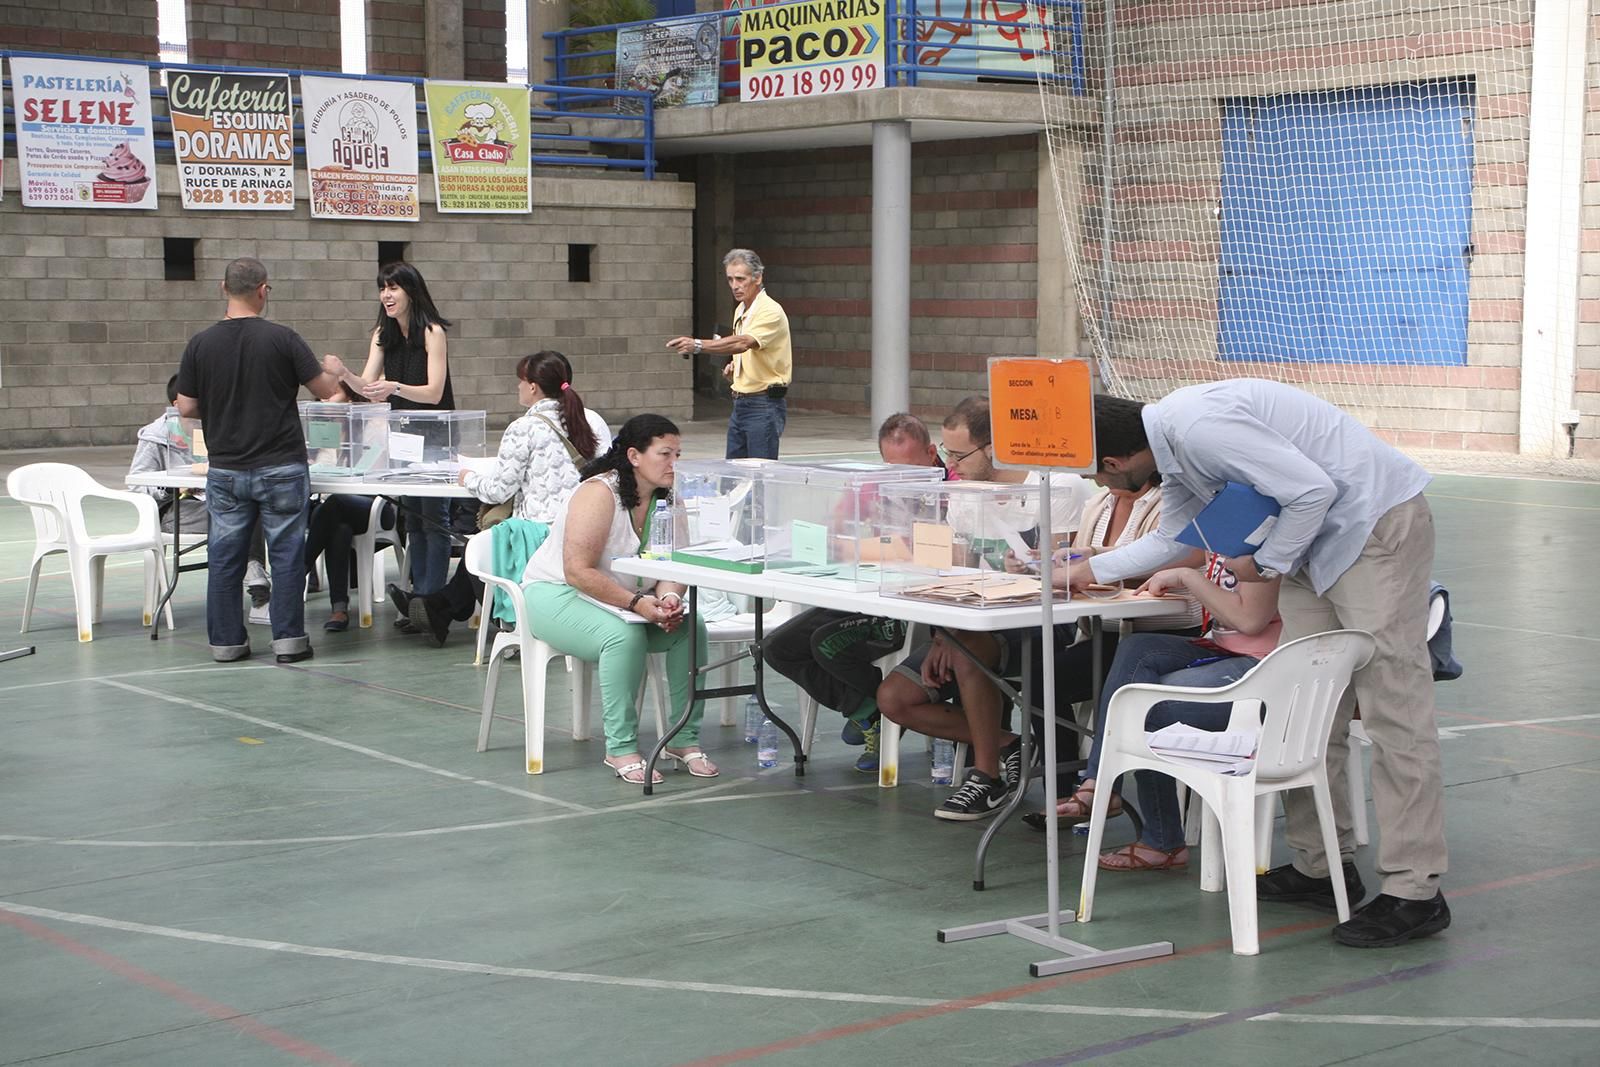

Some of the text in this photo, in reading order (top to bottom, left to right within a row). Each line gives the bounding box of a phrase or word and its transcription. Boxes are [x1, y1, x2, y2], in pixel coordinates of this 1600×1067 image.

[744, 0, 880, 32] MAQUINARIAS
[23, 75, 123, 92] PASTELERÍA
[749, 64, 876, 100] 902 18 99 99
[171, 74, 288, 120] Cafetería
[24, 98, 135, 126] SELENE
[344, 92, 378, 104] ASADERO
[380, 100, 390, 110] DE
[390, 109, 408, 140] POLLOS
[40, 124, 76, 133] Servicio
[88, 126, 128, 135] domicilio
[212, 112, 288, 131] ESQUINA
[175, 130, 292, 161] DORAMAS
[454, 148, 504, 160] Casa Eladio
[184, 166, 195, 175] C/
[198, 166, 260, 178] DORAMAS,
[280, 168, 286, 176] 2
[370, 174, 384, 182] POR
[184, 178, 292, 188] RUCE DE ARINAGA
[192, 188, 224, 203] 928
[229, 190, 260, 204] 183
[316, 191, 350, 199] CRUCE
[352, 192, 366, 200] DE
[337, 202, 359, 214] 928
[364, 204, 378, 214] 18
[382, 204, 396, 215] 38
[399, 206, 414, 216] 89
[1010, 408, 1038, 420] MESA
